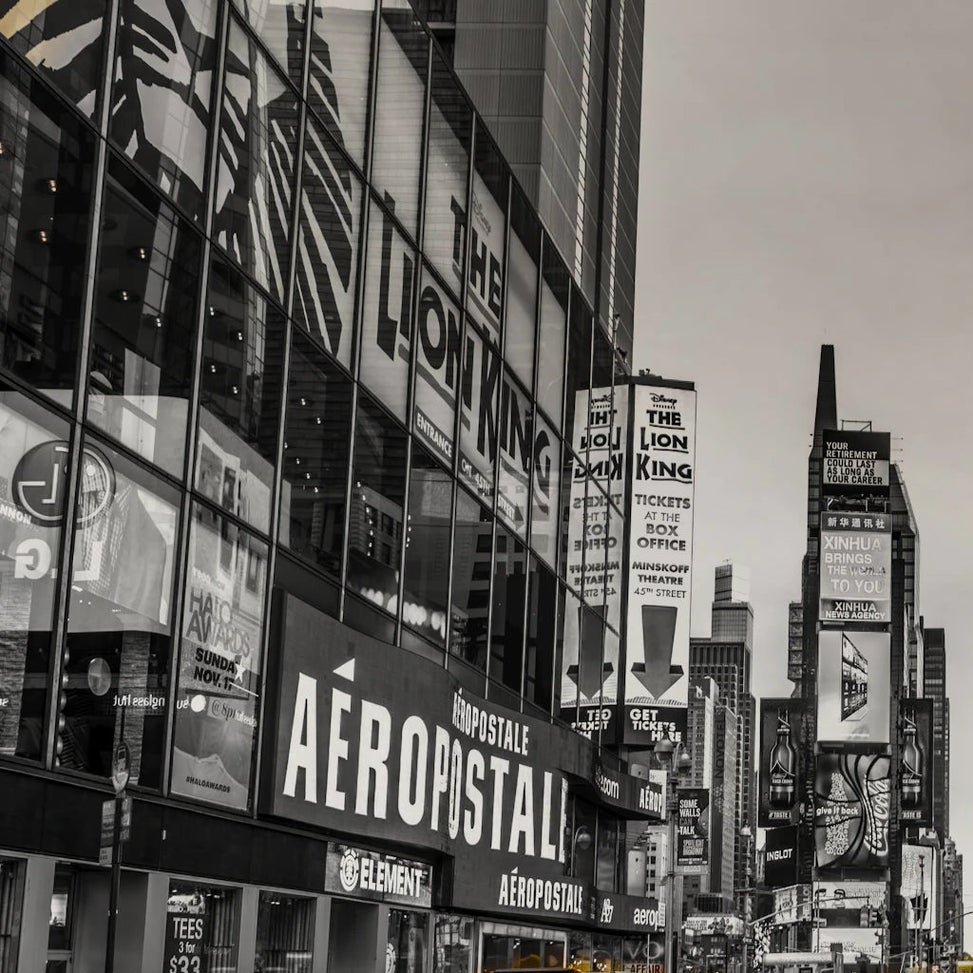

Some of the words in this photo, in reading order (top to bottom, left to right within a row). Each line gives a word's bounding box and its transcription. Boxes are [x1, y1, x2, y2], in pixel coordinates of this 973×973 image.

[450, 194, 501, 320] THE
[376, 189, 474, 412] LION
[477, 322, 552, 502] KING
[646, 409, 682, 426] THE
[416, 411, 453, 458] ENTRANCE
[640, 427, 688, 450] LION
[826, 441, 849, 450] YOUR
[826, 450, 878, 459] RETIREMENT
[636, 453, 692, 481] KING
[827, 459, 854, 468] COULD
[856, 460, 876, 468] LAST
[827, 467, 838, 475] AS
[840, 468, 862, 476] LONG
[864, 469, 875, 477] AS
[827, 475, 849, 484] YOUR
[851, 476, 883, 485] CAREER
[634, 494, 691, 509] TICKETS
[644, 511, 657, 521] AT
[661, 512, 681, 523] THE
[646, 523, 678, 537] BOX
[637, 537, 687, 551] OFFICE
[823, 536, 882, 550] XINHUA
[825, 552, 872, 565] BRINGS
[632, 561, 690, 573] MINSKOFF
[827, 565, 848, 576] THE
[638, 574, 684, 586] THEATRE
[830, 579, 850, 592] TO
[854, 580, 885, 594] YOU
[634, 588, 653, 596] 45TH
[656, 588, 687, 599] STREET
[834, 601, 877, 612] XINHUA
[825, 610, 850, 618] NEWS
[851, 611, 886, 620] AGENCY
[193, 666, 221, 688] NOV.
[223, 676, 235, 692] 17
[629, 708, 659, 721] GET
[452, 687, 529, 756] AÉROPOSTALE
[632, 721, 676, 732] TICKETS
[715, 714, 726, 780] NOVOTEL
[186, 775, 231, 793] #HALOAWARDS
[679, 799, 698, 809] SOME
[816, 806, 832, 816] give
[833, 805, 841, 815] it
[841, 805, 859, 816] back
[680, 808, 701, 818] WALLS
[679, 826, 696, 835] TALK
[767, 849, 793, 862] INGLOT
[359, 857, 424, 898] ELEMENT
[498, 866, 583, 915] AÉROPOSTALE
[173, 916, 204, 940] TEES
[178, 941, 185, 954] 3
[185, 941, 196, 954] for
